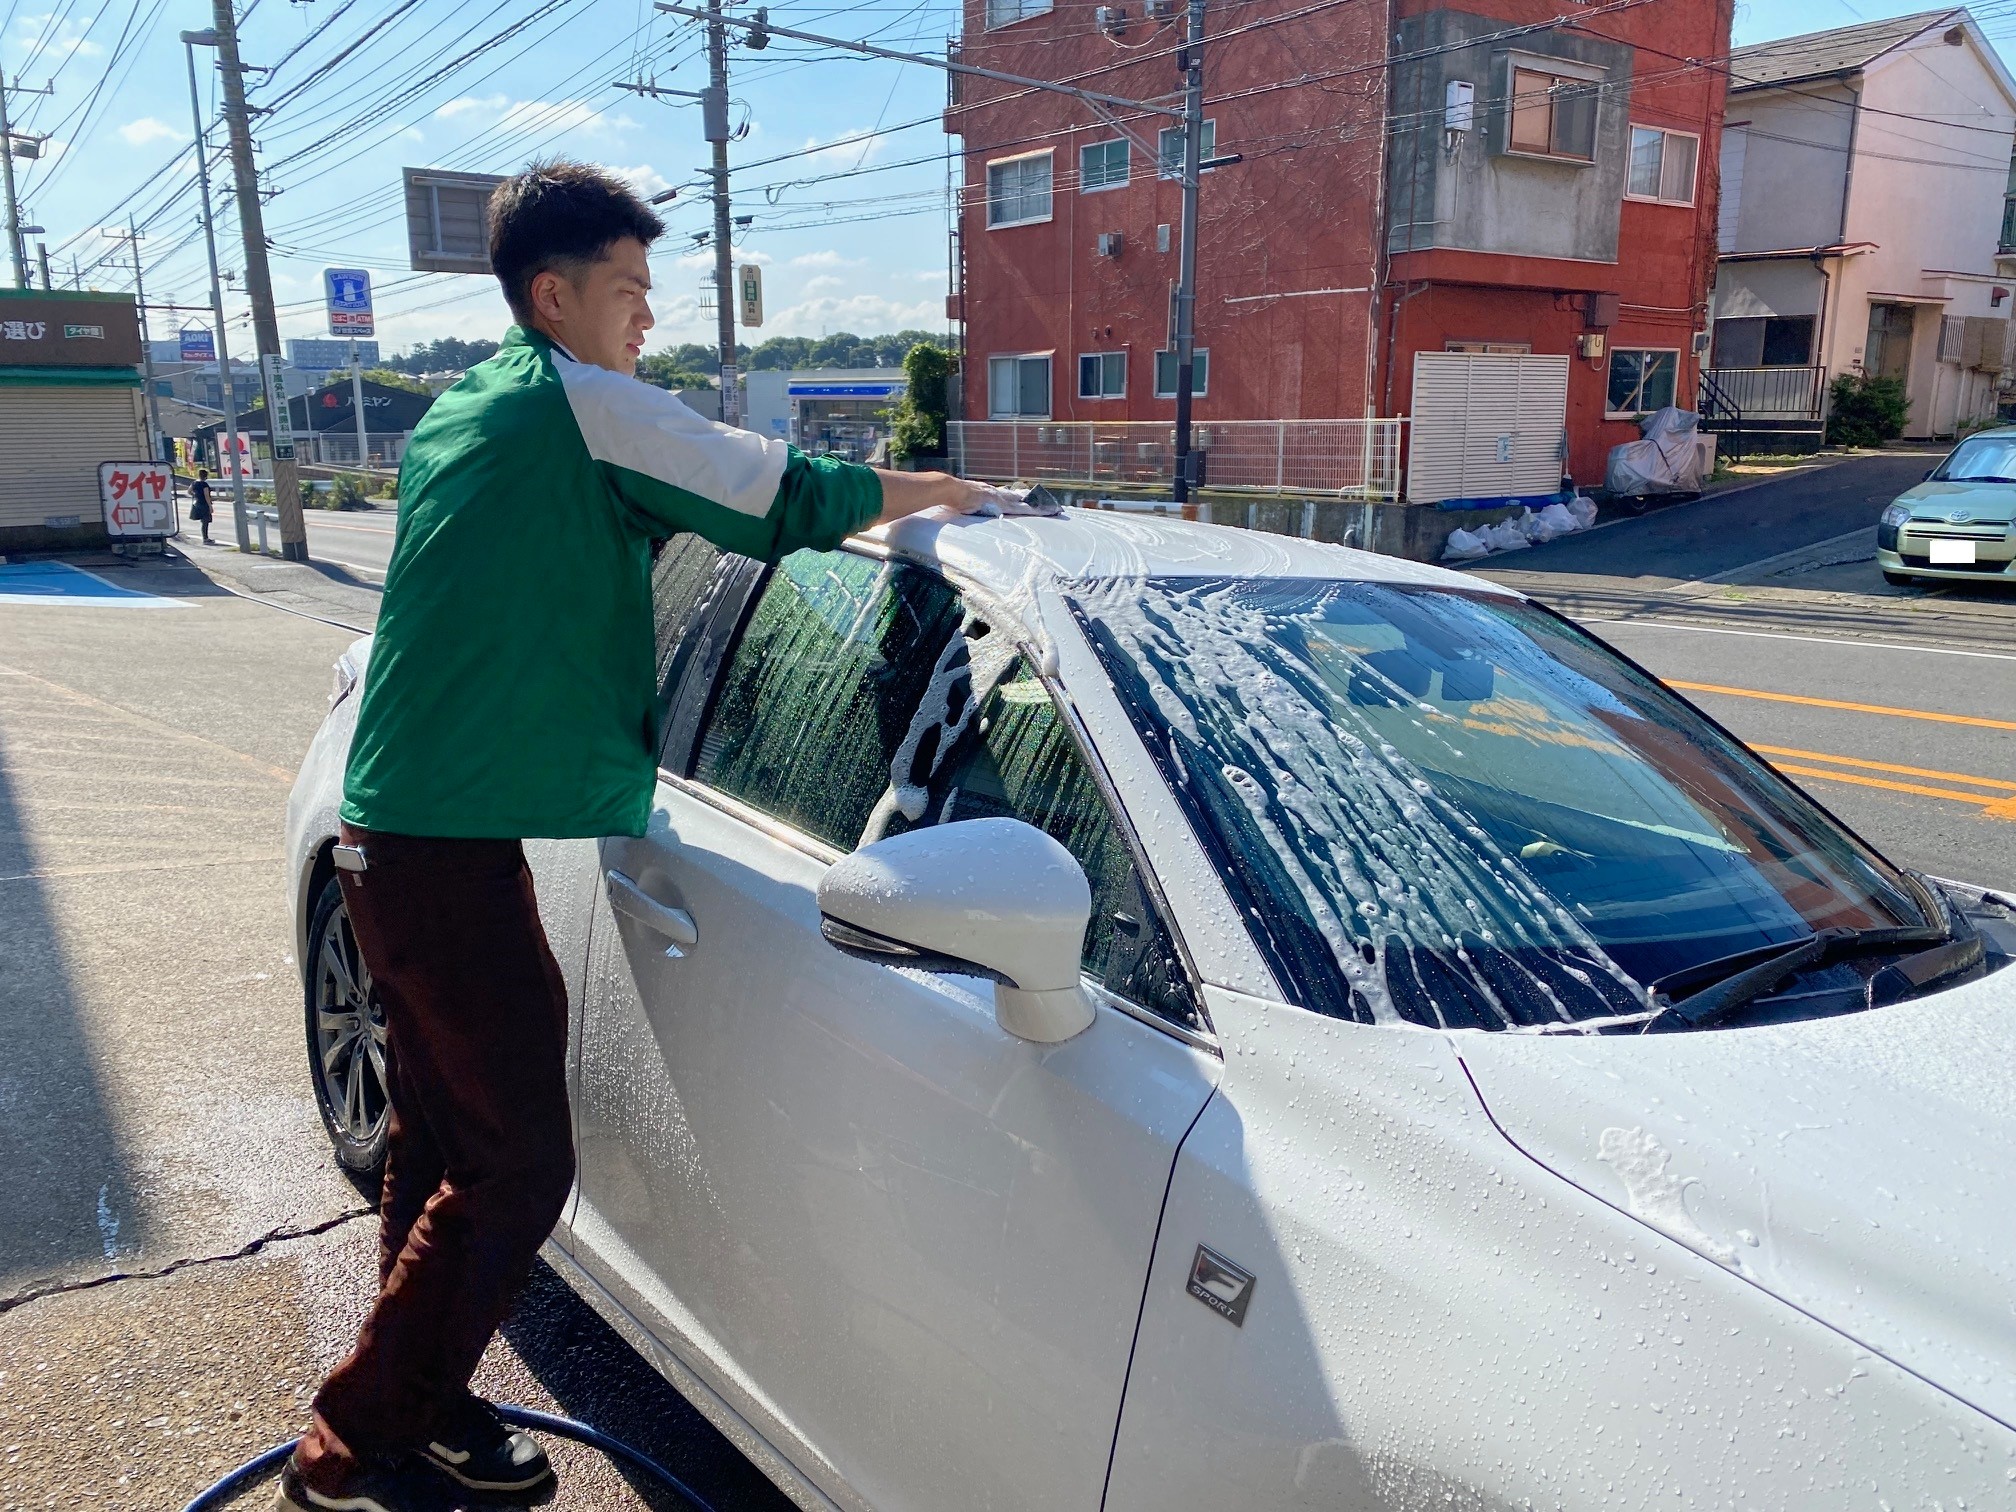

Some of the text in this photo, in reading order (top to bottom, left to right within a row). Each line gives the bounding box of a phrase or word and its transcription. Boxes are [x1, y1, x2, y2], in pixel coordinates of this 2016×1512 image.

[331, 273, 366, 282] LAWSON
[357, 315, 371, 323] ATM
[0, 320, 46, 340] 選び
[184, 333, 209, 343] AOKI
[345, 396, 391, 407] バミヤン
[108, 470, 166, 500] タイヤ
[141, 502, 167, 528] P
[1192, 1285, 1237, 1316] SPORT
